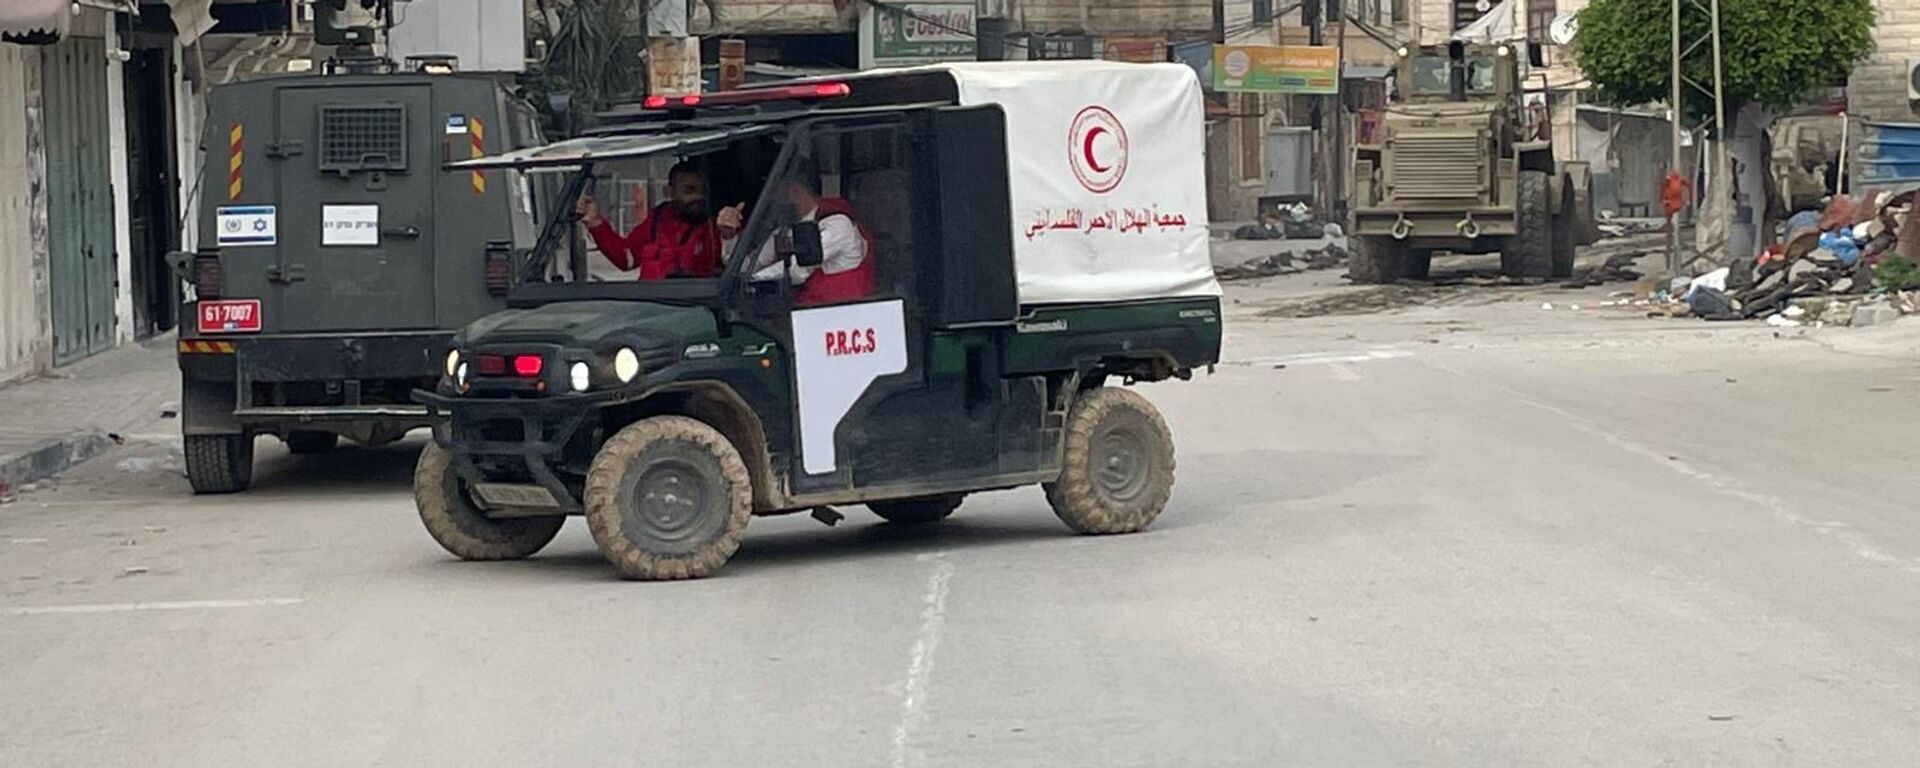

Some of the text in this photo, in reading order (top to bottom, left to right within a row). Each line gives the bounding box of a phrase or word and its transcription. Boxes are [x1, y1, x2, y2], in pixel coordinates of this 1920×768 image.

[1025, 207, 1082, 241] الفلسطيني
[1120, 208, 1151, 233] الهلال
[1153, 203, 1186, 232] جمعية
[826, 328, 876, 356] P.R.C.S
